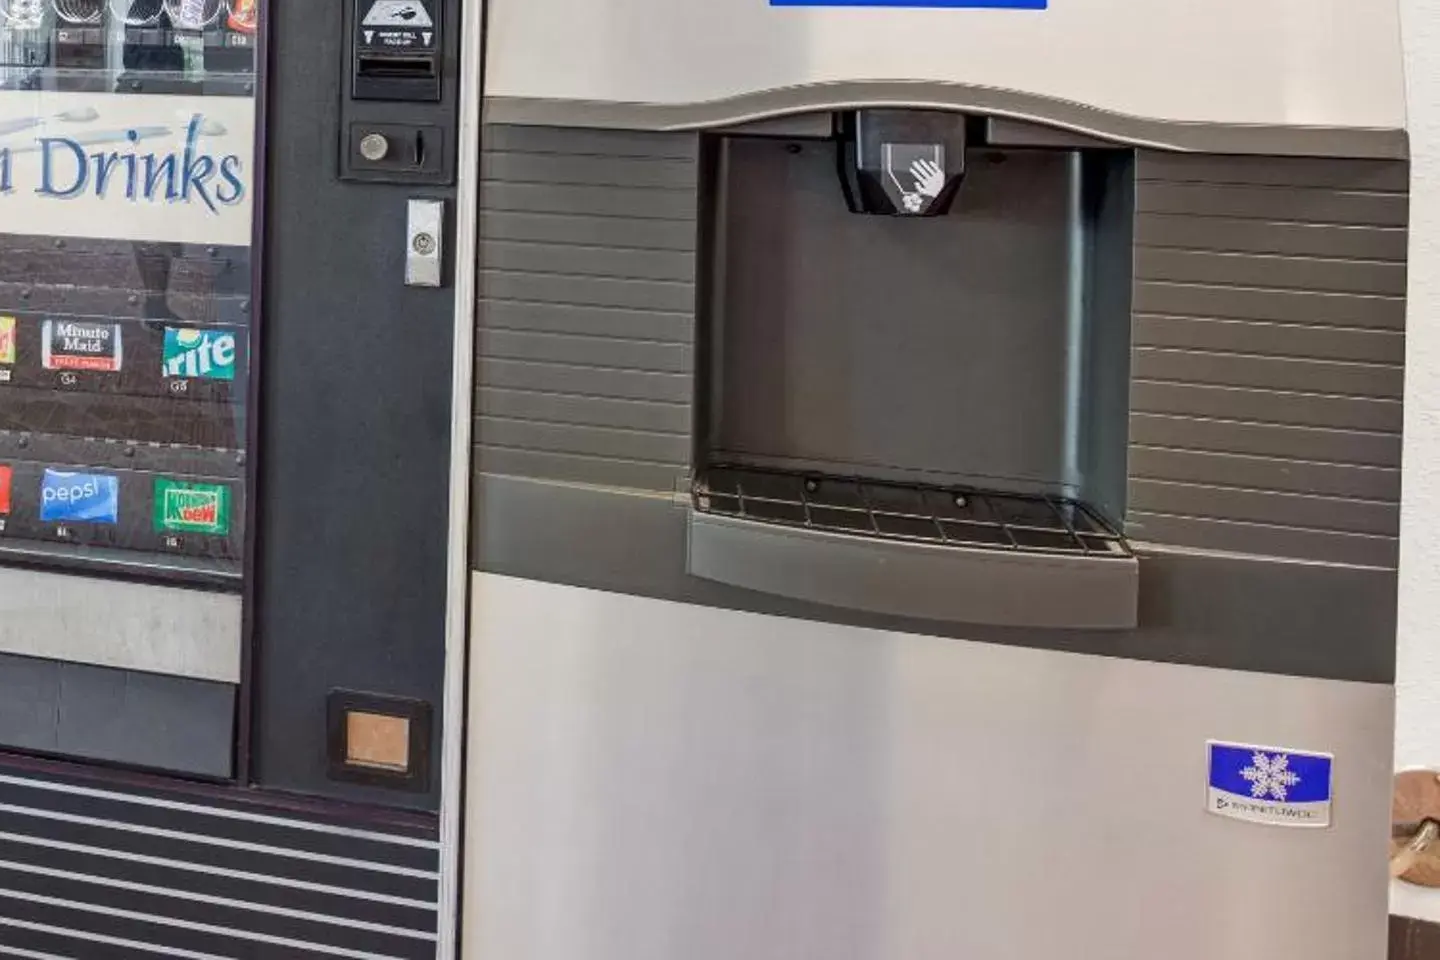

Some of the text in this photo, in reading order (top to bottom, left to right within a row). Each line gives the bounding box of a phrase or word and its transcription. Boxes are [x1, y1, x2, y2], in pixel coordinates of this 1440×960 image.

[34, 113, 245, 215] Drinks
[57, 323, 110, 340] Minute
[63, 337, 103, 352] Maid
[42, 477, 100, 505] pepsi
